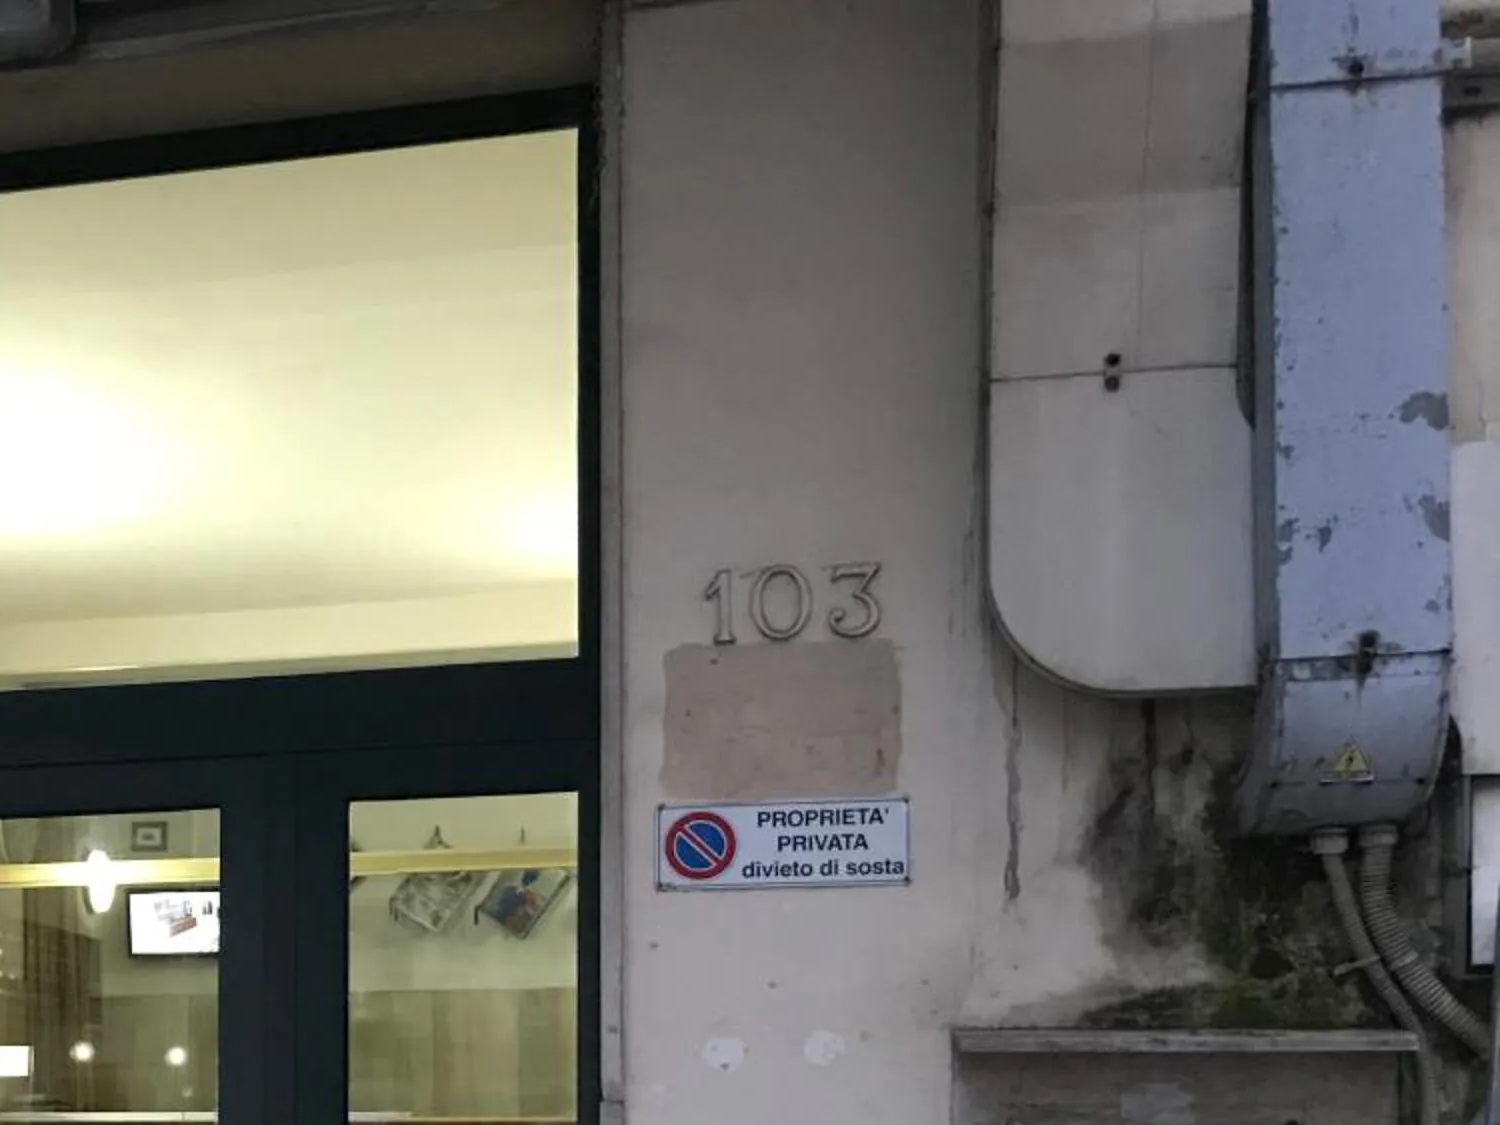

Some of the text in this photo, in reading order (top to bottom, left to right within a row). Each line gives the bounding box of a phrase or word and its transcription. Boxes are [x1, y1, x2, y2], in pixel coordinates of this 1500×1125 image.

[704, 561, 882, 646] 103
[757, 807, 889, 828] PROPRIETA'
[777, 833, 869, 852] PRIVATA
[742, 858, 905, 878] divieto di sosta
